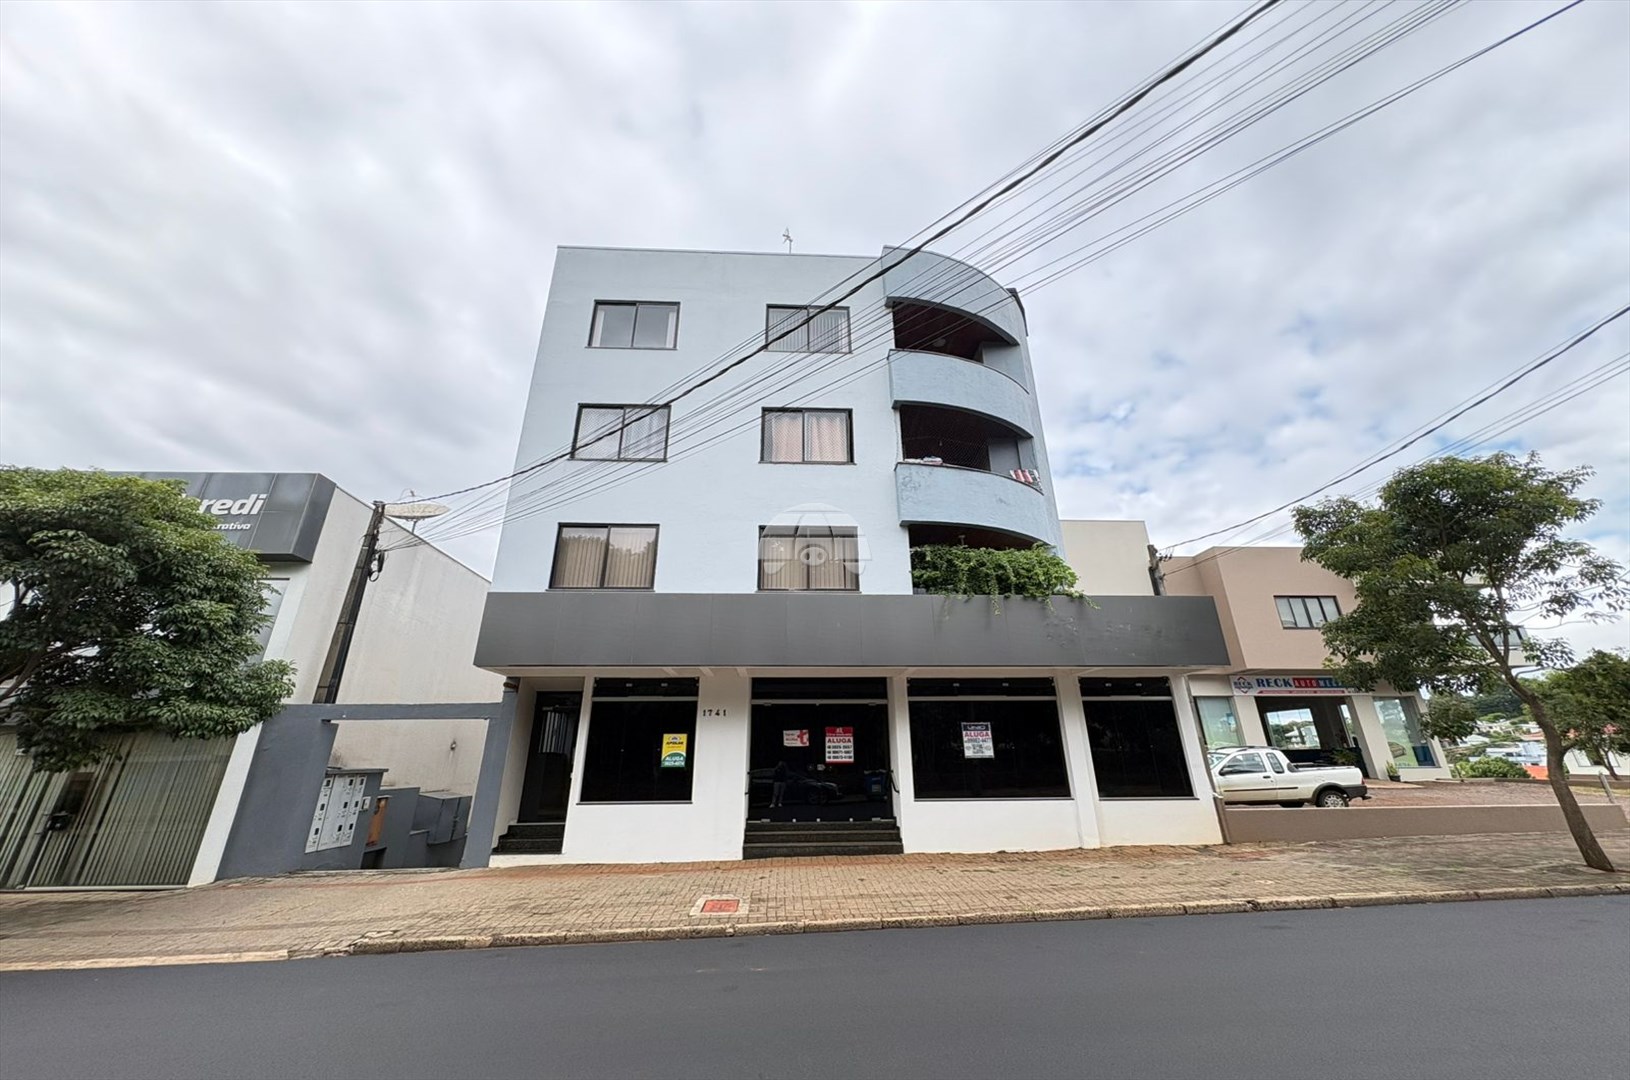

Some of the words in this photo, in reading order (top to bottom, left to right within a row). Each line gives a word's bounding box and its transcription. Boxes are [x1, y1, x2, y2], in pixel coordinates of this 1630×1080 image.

[197, 494, 268, 515] redi
[1256, 678, 1293, 688] RECK
[702, 709, 727, 717] 1741
